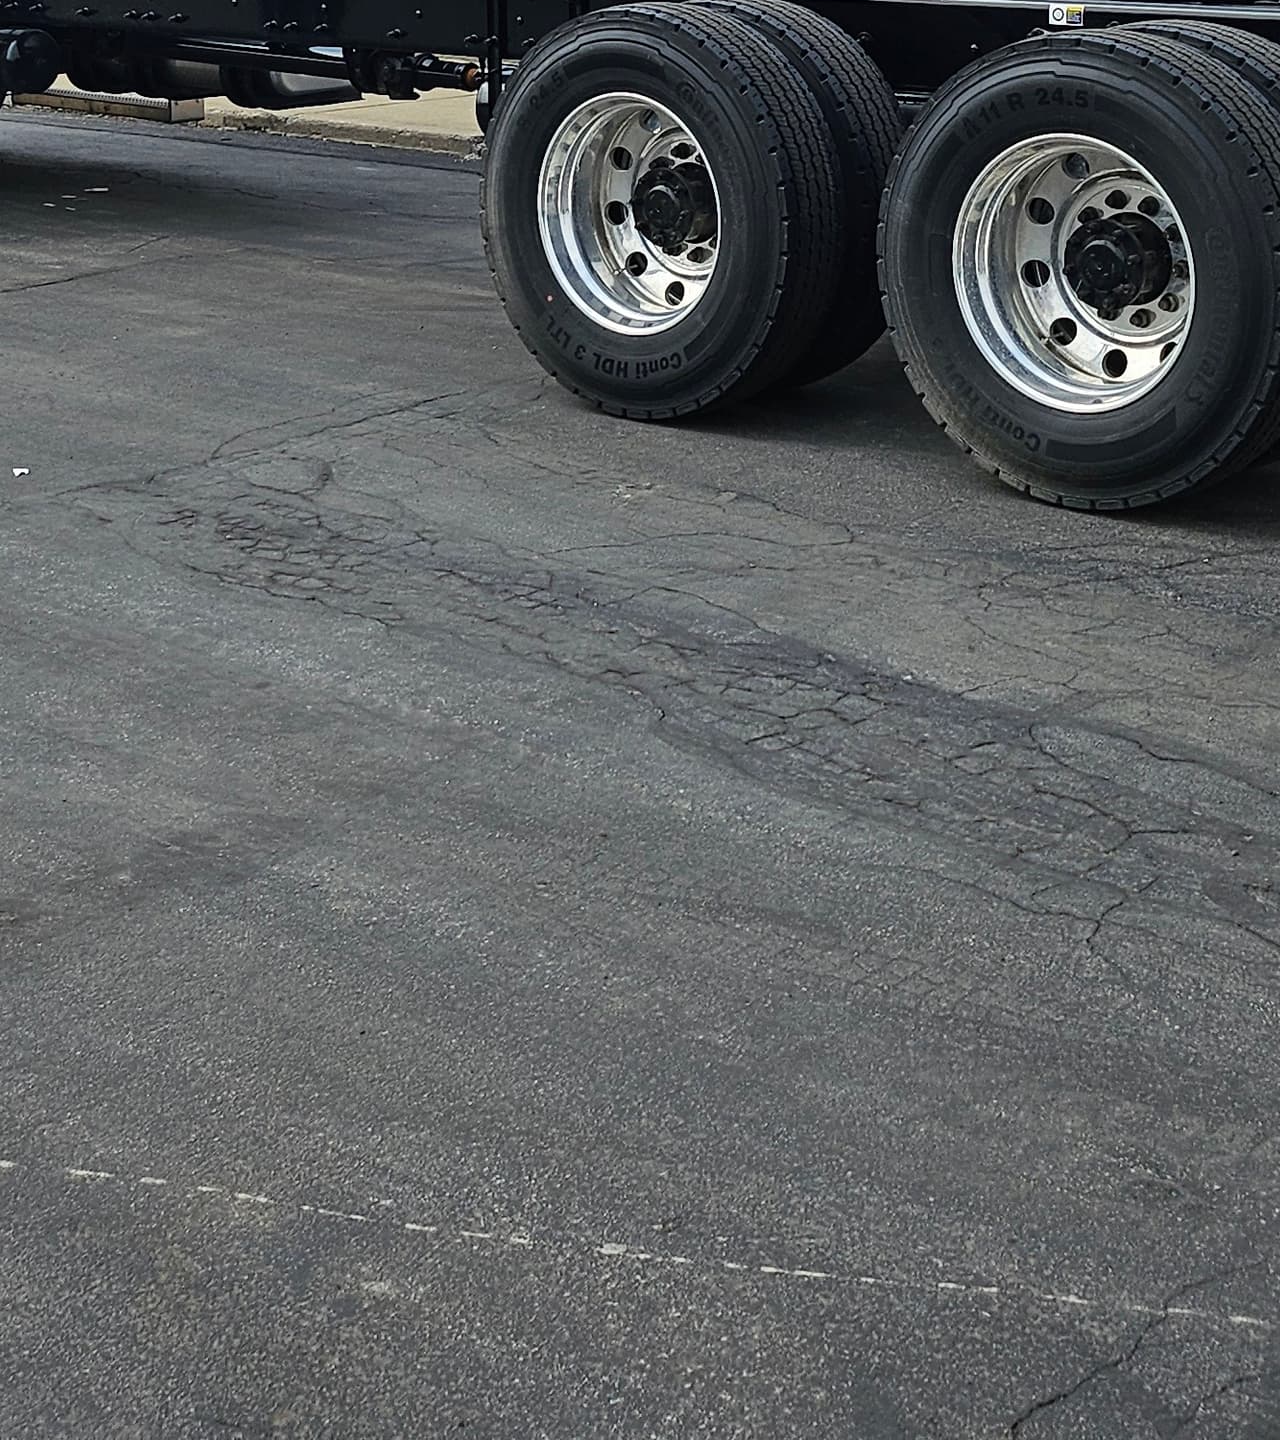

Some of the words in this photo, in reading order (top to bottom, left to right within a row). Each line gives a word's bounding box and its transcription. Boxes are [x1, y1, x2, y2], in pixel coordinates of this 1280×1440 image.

[1034, 87, 1089, 108] 24.5
[592, 351, 629, 378] HDL
[633, 351, 684, 380] Conti
